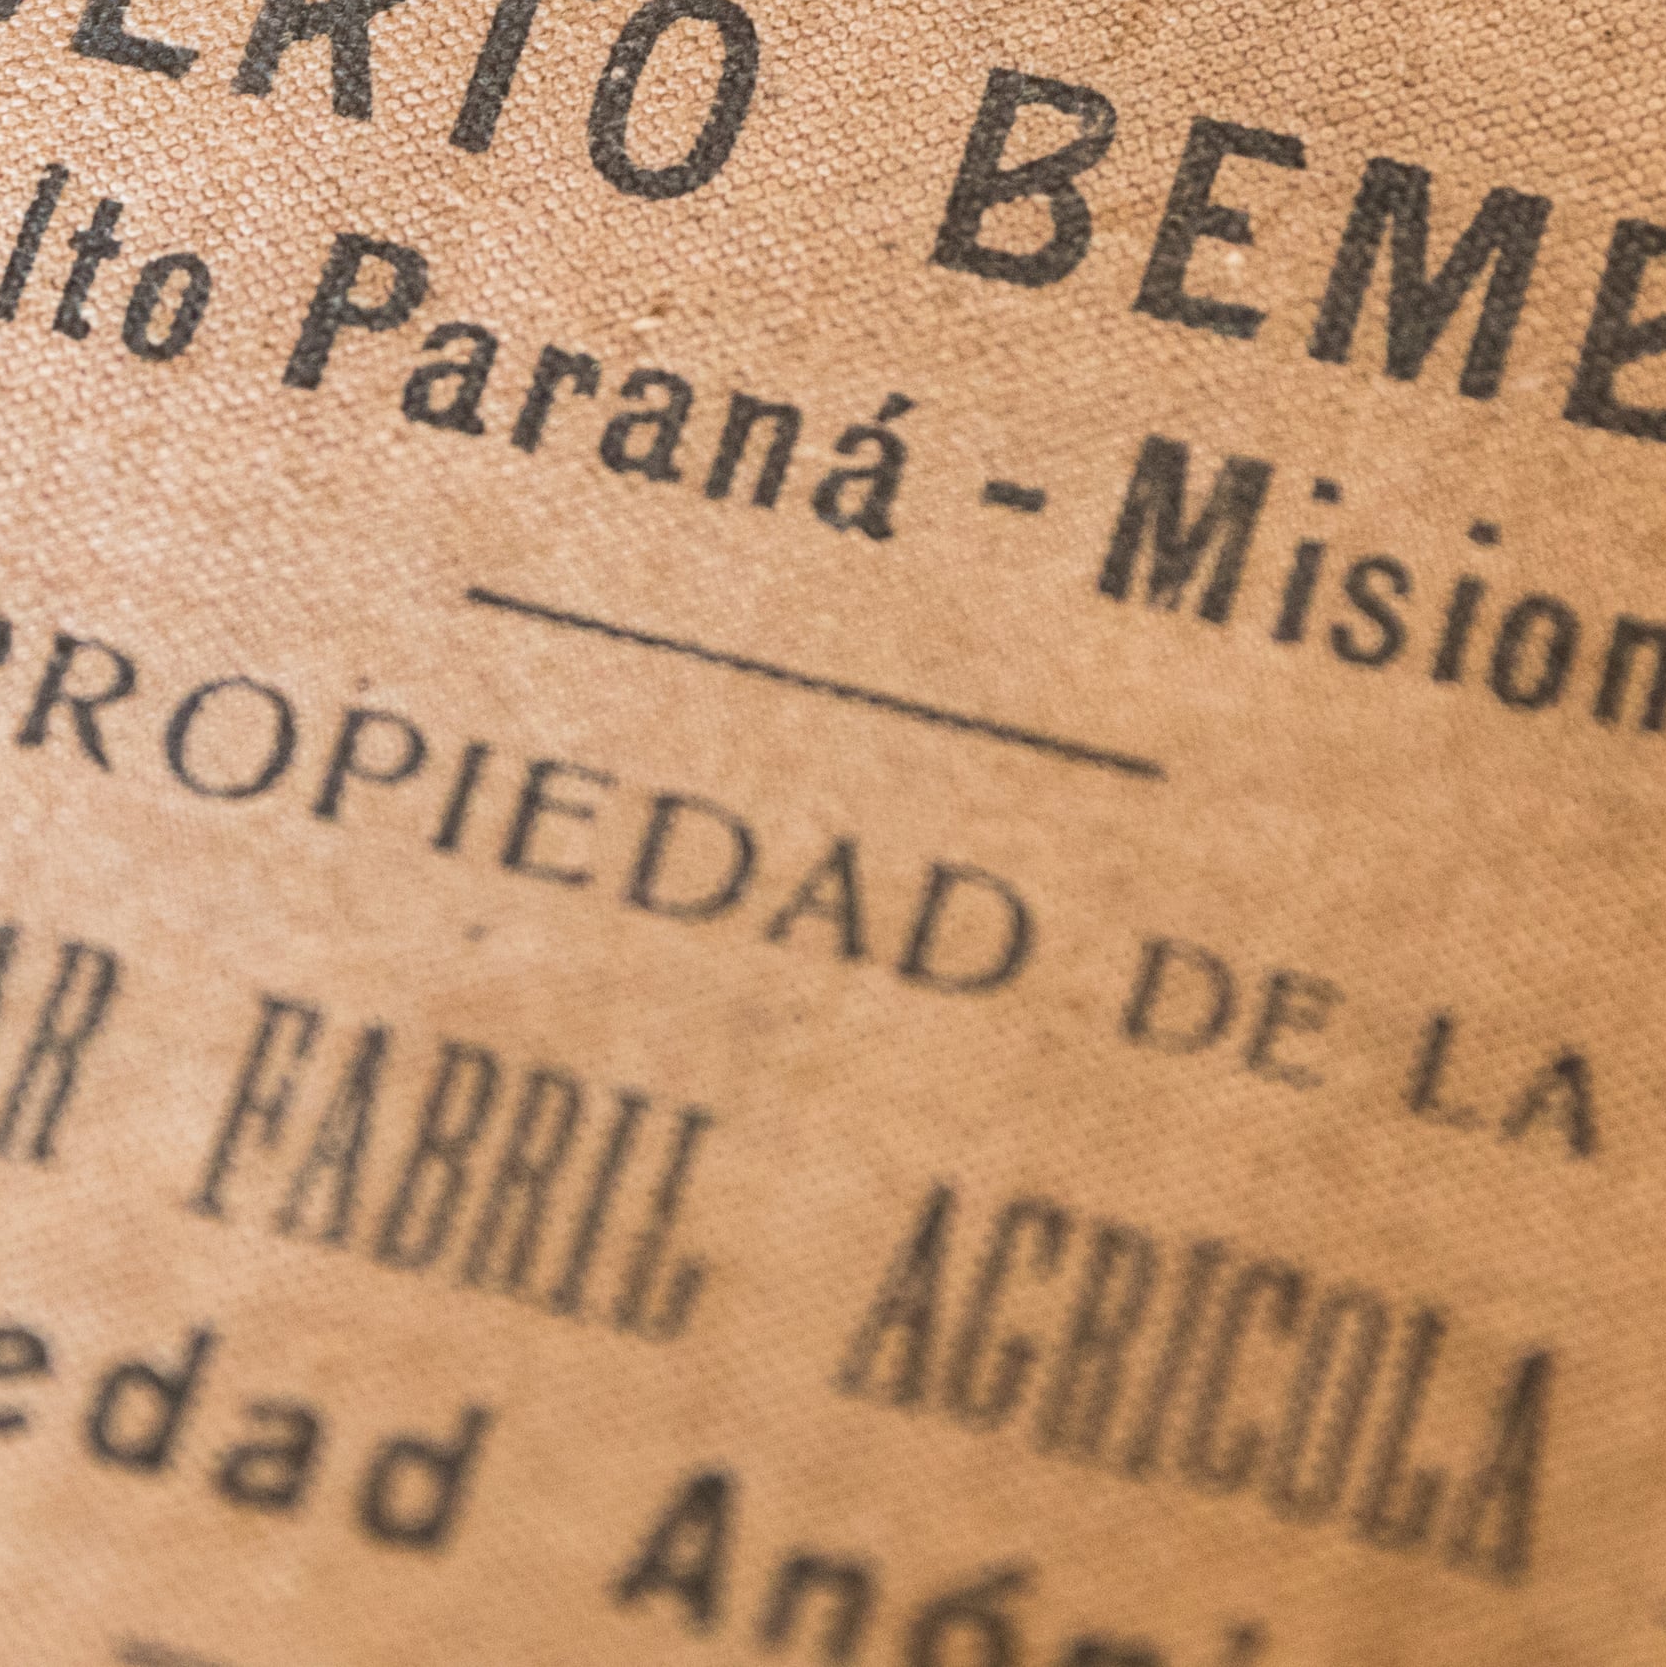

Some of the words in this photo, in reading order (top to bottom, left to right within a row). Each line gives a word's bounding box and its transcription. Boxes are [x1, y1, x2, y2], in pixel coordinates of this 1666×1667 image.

[281, 230, 917, 545] Paraná
[1119, 934, 1342, 1074] DE
[1396, 1009, 1605, 1163] LA
[189, 989, 719, 1340] FABRIL
[836, 1180, 1561, 1589] AGRICOLA
